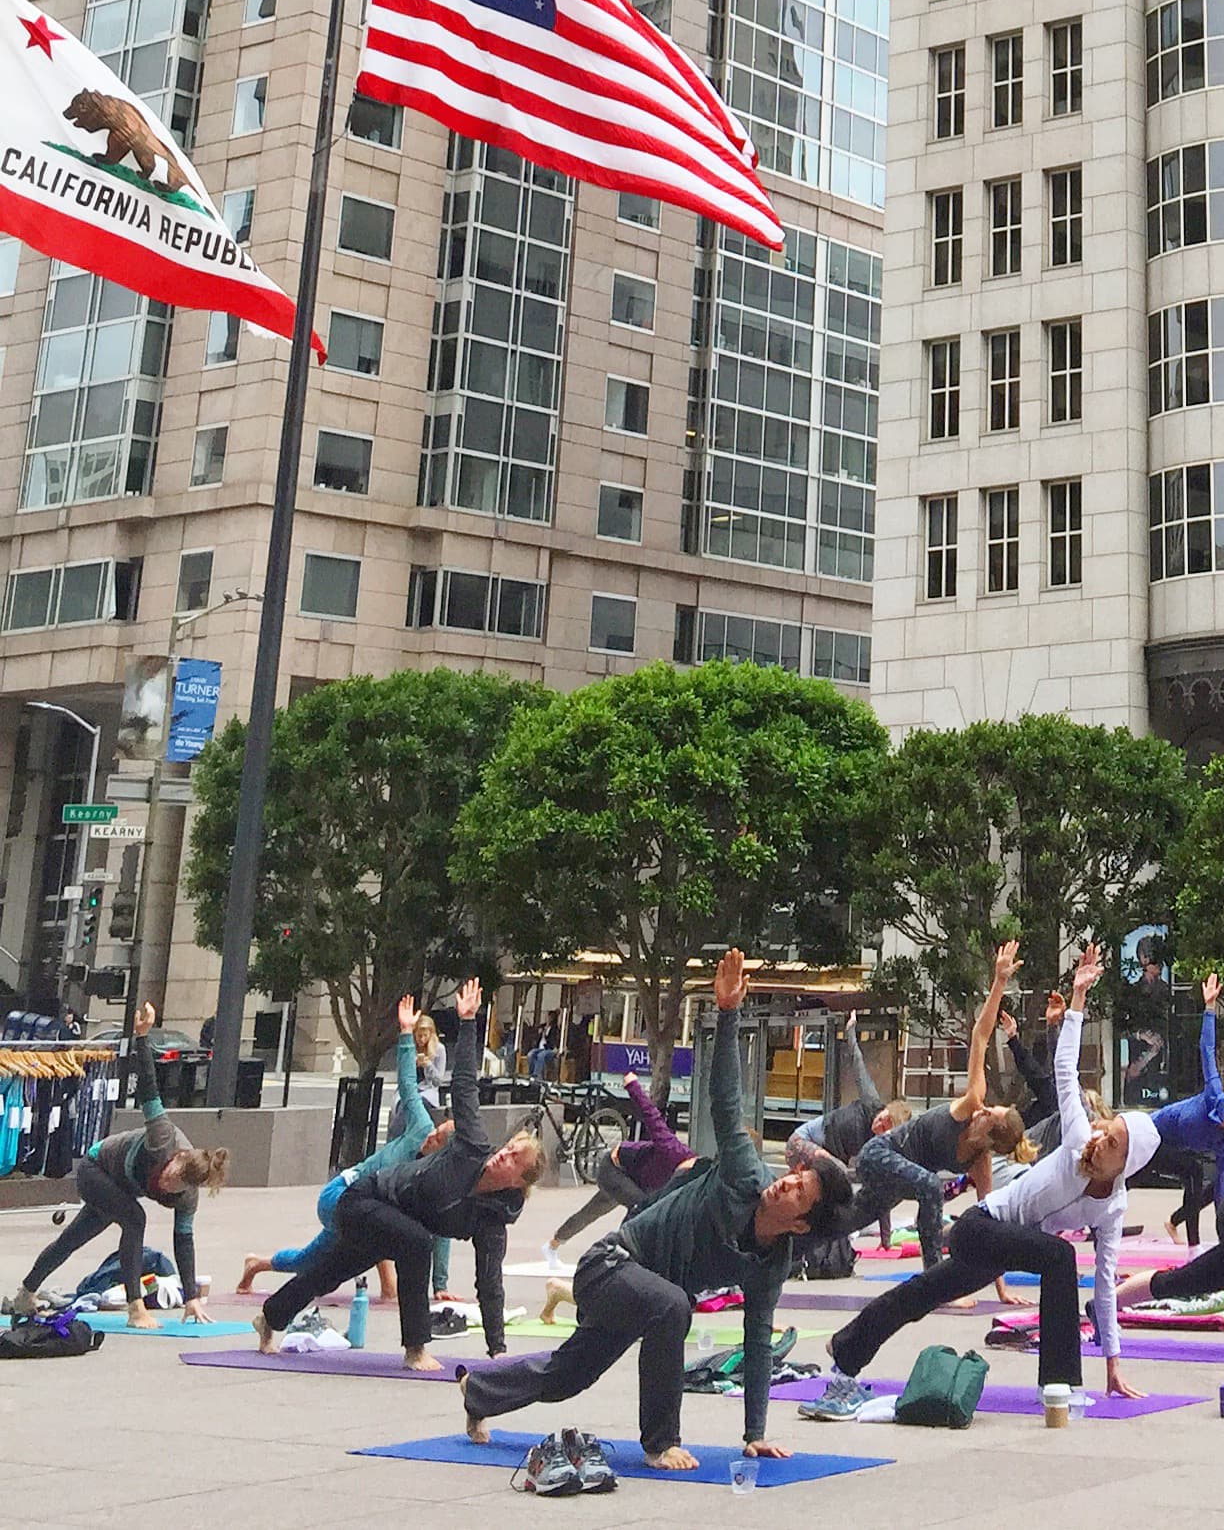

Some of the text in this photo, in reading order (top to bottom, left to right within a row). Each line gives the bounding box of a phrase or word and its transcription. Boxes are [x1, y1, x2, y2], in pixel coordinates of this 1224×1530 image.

[1, 147, 152, 239] CALIFORNIA
[175, 682, 220, 698] TURNER
[69, 808, 112, 820] Kearny
[94, 826, 143, 837] KEARNY
[625, 1046, 651, 1066] YAH
